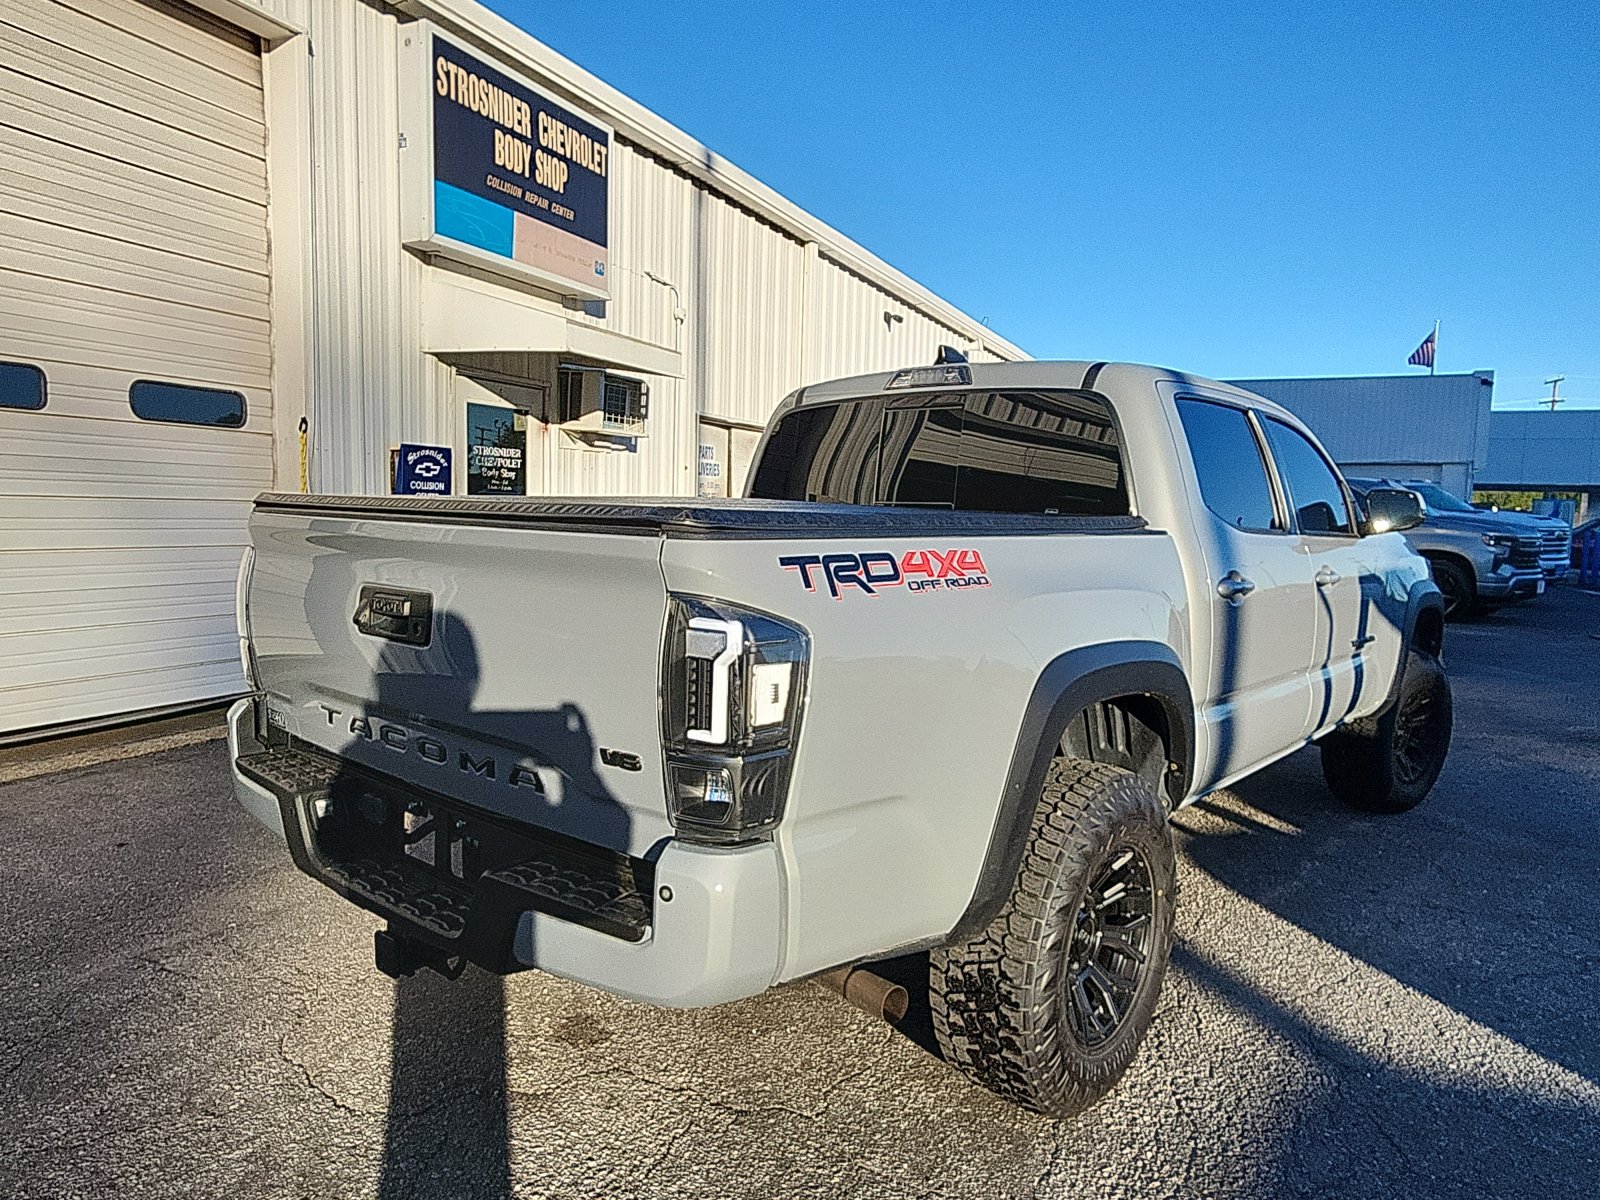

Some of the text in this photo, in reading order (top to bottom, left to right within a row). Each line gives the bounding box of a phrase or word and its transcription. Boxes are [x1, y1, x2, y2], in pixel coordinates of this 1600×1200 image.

[436, 55, 608, 178] STROSNIDER CHEVROLET
[494, 128, 568, 194] BODY SHOP
[486, 174, 575, 222] COLLISION REPAIR CENTER
[407, 449, 448, 466] Strosnider
[473, 445, 521, 458] STROSNIDER
[410, 480, 445, 491] COLLISION
[779, 552, 904, 600] TRD
[908, 575, 991, 594] OFF ROAD
[320, 703, 546, 796] TACOMA
[599, 747, 642, 772] V6
